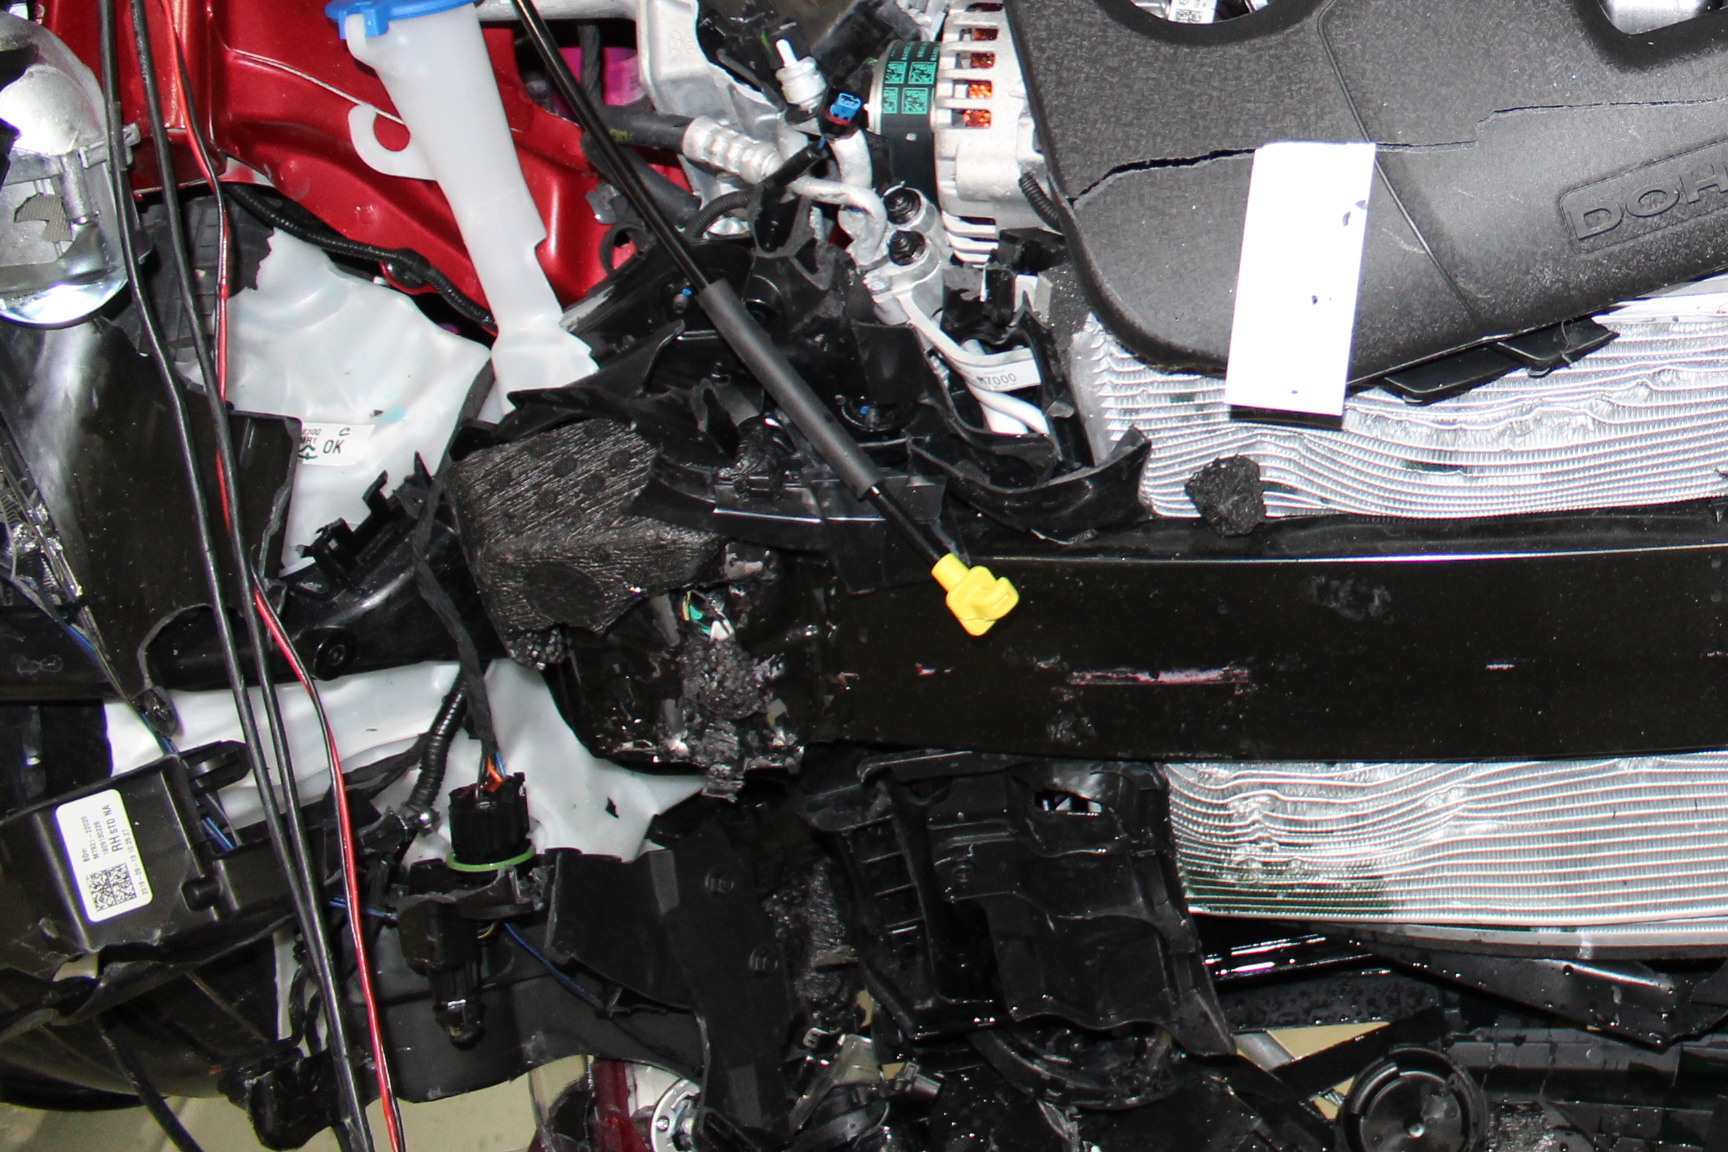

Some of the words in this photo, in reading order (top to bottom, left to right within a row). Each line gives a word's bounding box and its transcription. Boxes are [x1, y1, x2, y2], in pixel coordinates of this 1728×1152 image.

[322, 439, 346, 454] OK
[102, 803, 113, 817] NA
[106, 818, 118, 836] STD
[110, 835, 124, 853] RH
